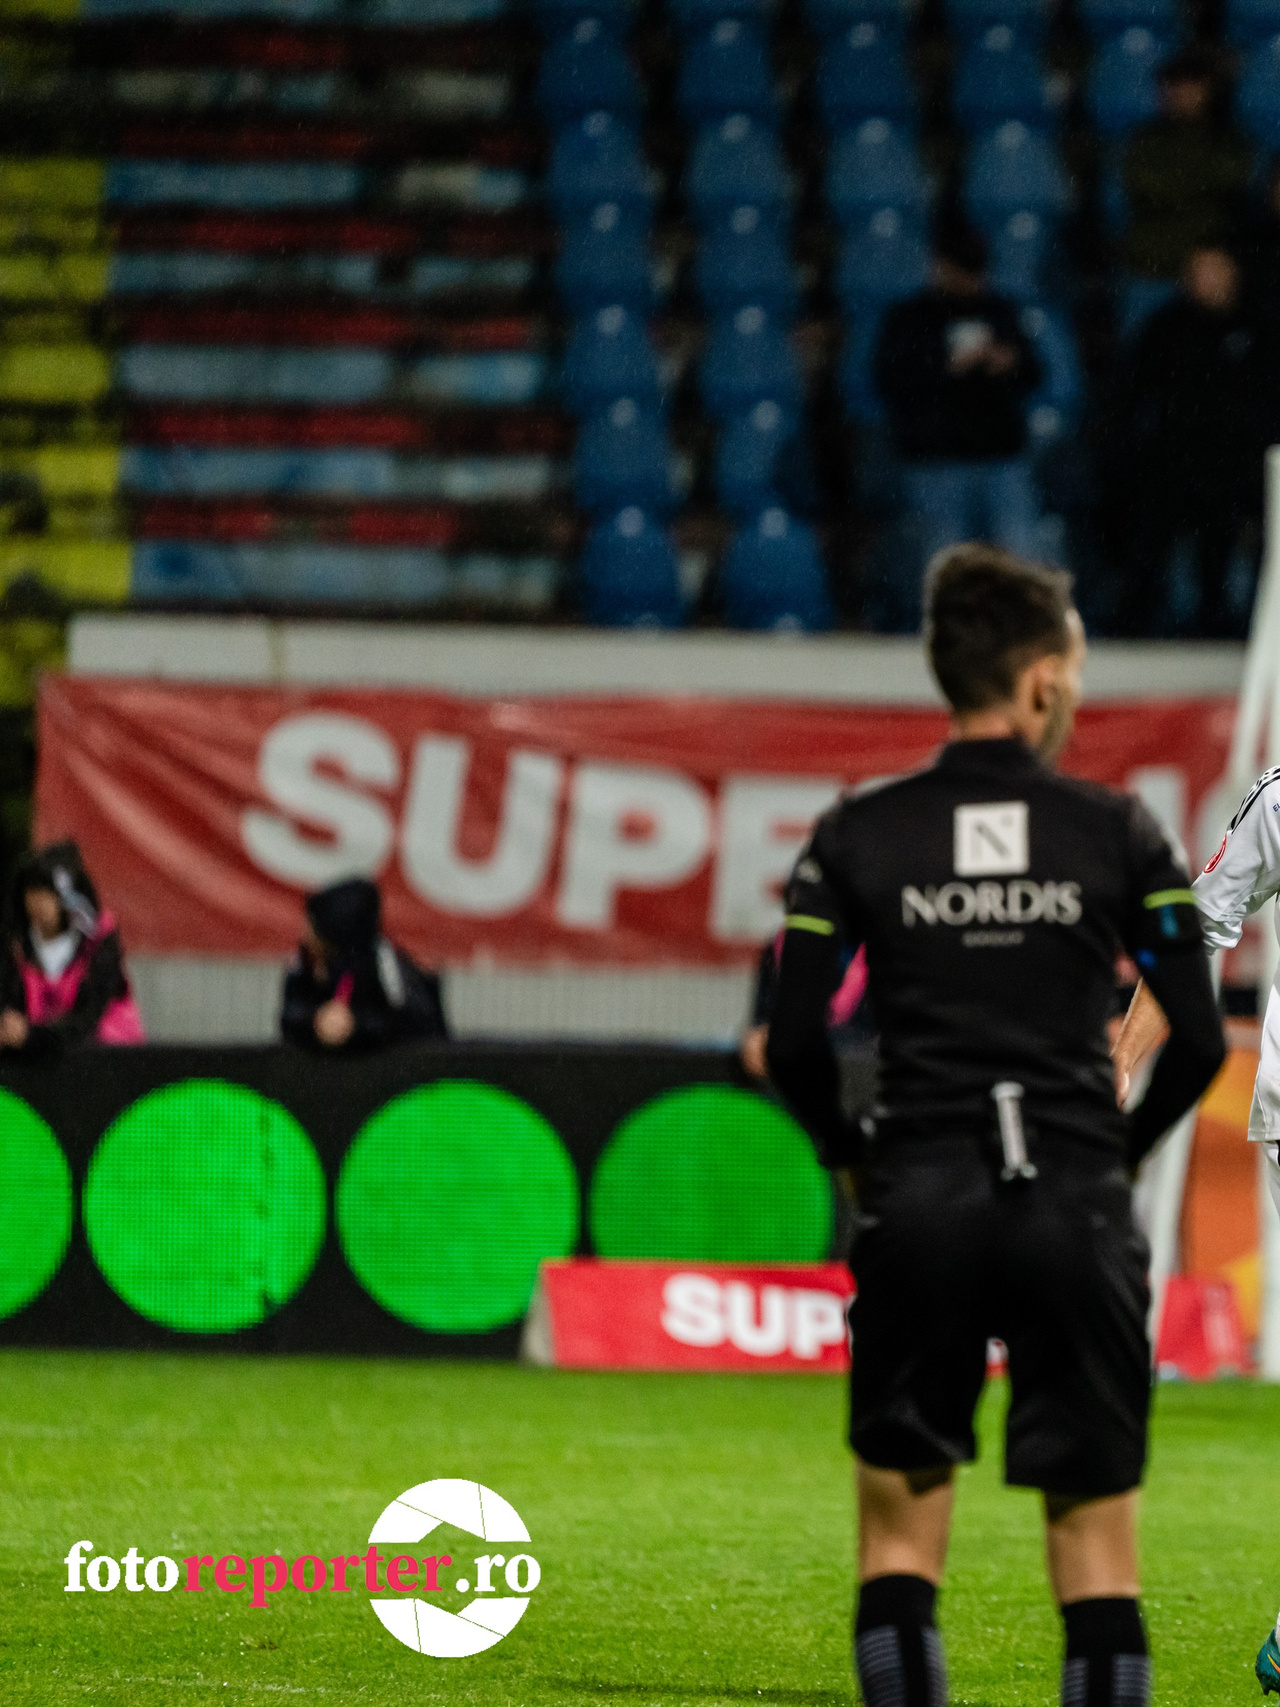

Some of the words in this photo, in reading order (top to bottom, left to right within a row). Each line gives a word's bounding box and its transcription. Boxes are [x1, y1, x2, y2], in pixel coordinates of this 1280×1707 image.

[239, 709, 848, 945] SUPE
[901, 879, 1083, 929] NORDIS
[660, 1272, 846, 1360] SUP
